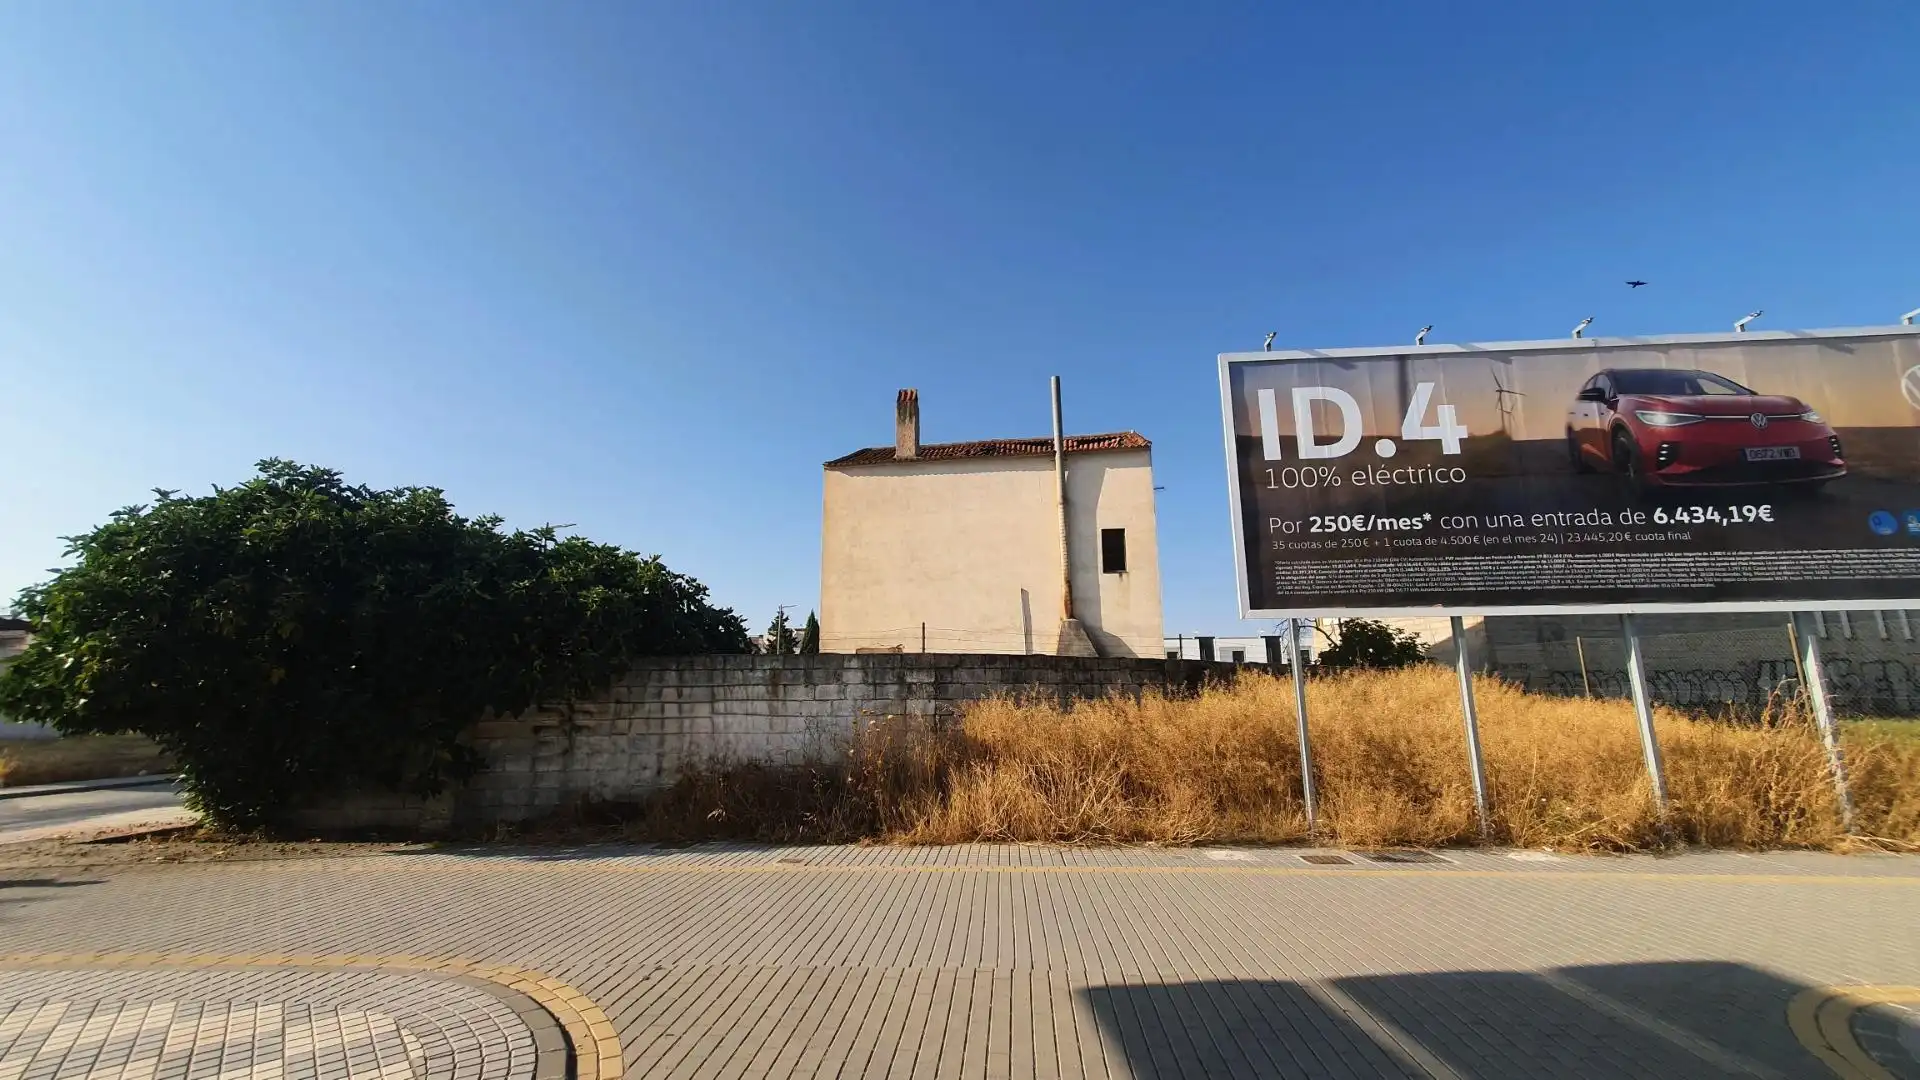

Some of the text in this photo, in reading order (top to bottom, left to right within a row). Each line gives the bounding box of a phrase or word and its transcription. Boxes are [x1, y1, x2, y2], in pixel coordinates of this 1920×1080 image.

[1257, 382, 1469, 461] ID.4
[1265, 463, 1467, 489] 100% eléctrico
[1269, 517, 1302, 534] Por
[1440, 515, 1478, 529] con
[1486, 514, 1524, 528] una
[1531, 508, 1613, 527] entrada
[1619, 507, 1646, 525] de
[1653, 504, 1775, 527] 6.434,19€
[1272, 540, 1286, 550] 35
[1288, 541, 1322, 549] cuotas
[1324, 539, 1337, 549] de
[1384, 537, 1390, 547] 1
[1393, 538, 1422, 547] cuota
[1424, 536, 1437, 546] de
[1483, 535, 1499, 546] (en
[1502, 534, 1512, 543] el
[1515, 535, 1537, 544] mes
[1540, 533, 1558, 544] 24)
[1635, 532, 1666, 541] cuota
[1668, 531, 1692, 540] final
